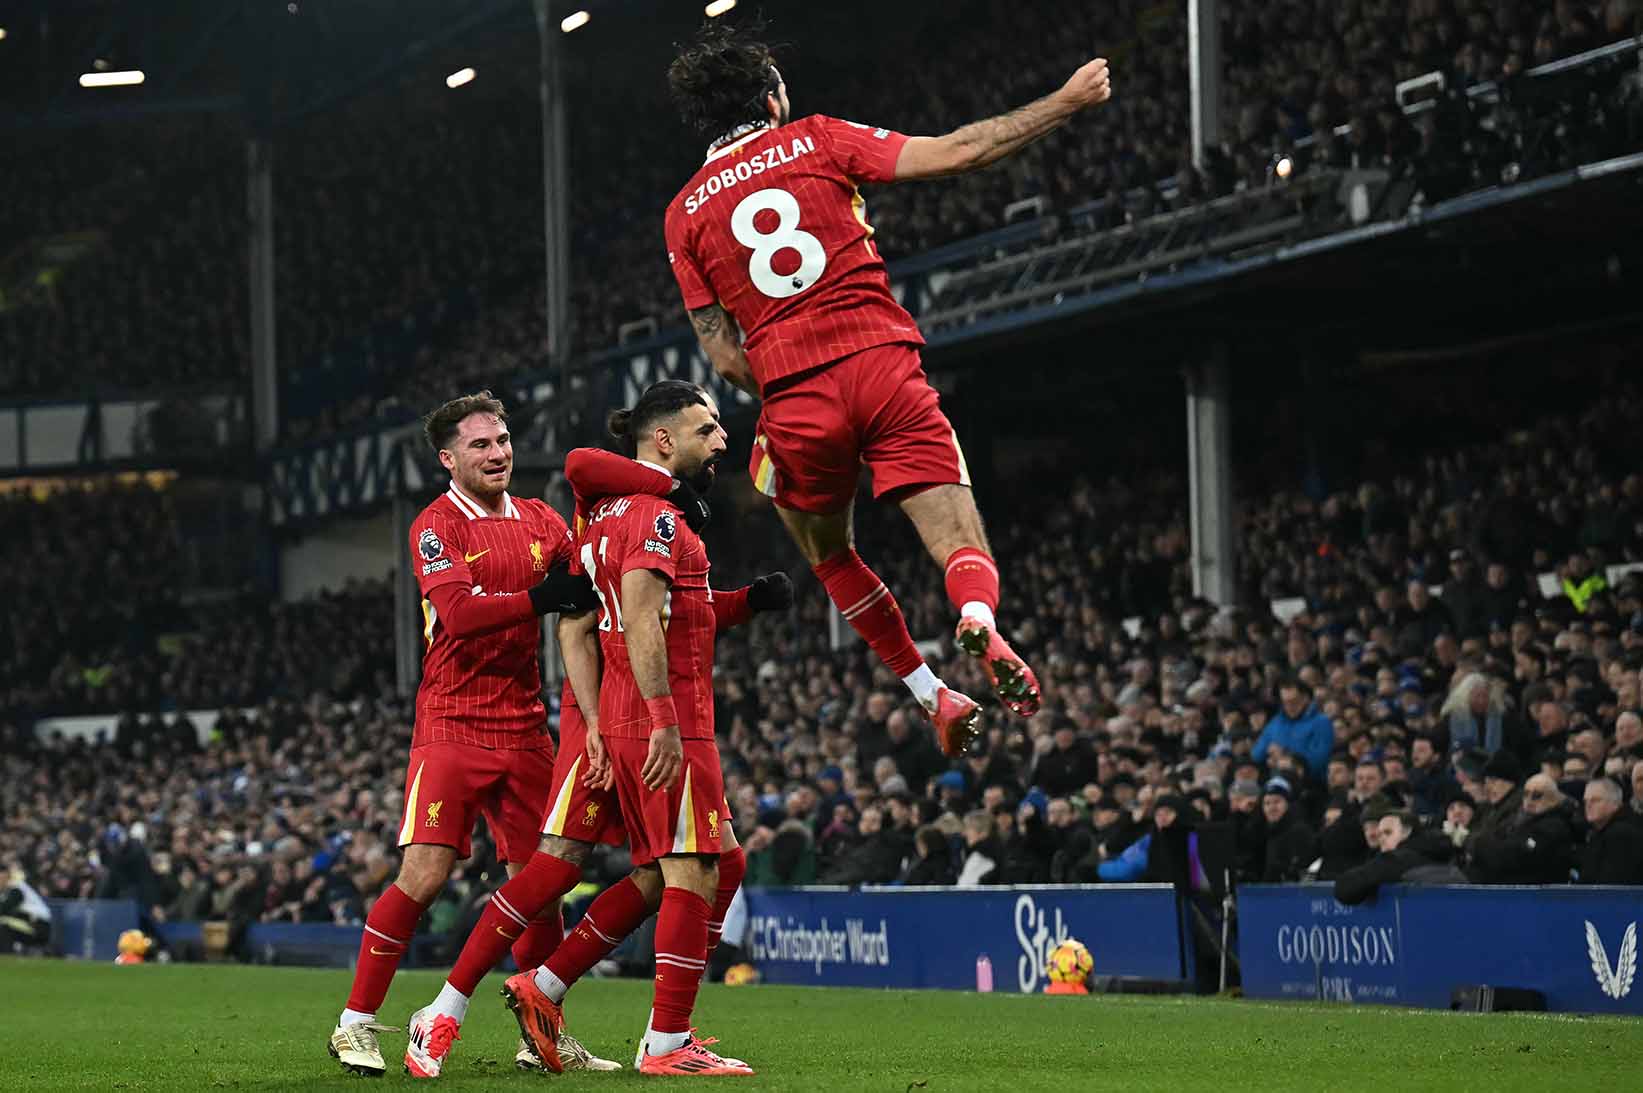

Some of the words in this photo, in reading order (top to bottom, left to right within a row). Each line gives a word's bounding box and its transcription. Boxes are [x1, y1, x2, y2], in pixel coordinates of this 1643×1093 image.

[684, 136, 816, 214] SZOBOSZLAI
[731, 188, 827, 298] 8
[764, 916, 847, 976] Christopher
[845, 918, 889, 966] Ward
[1278, 924, 1395, 966] GOODISON
